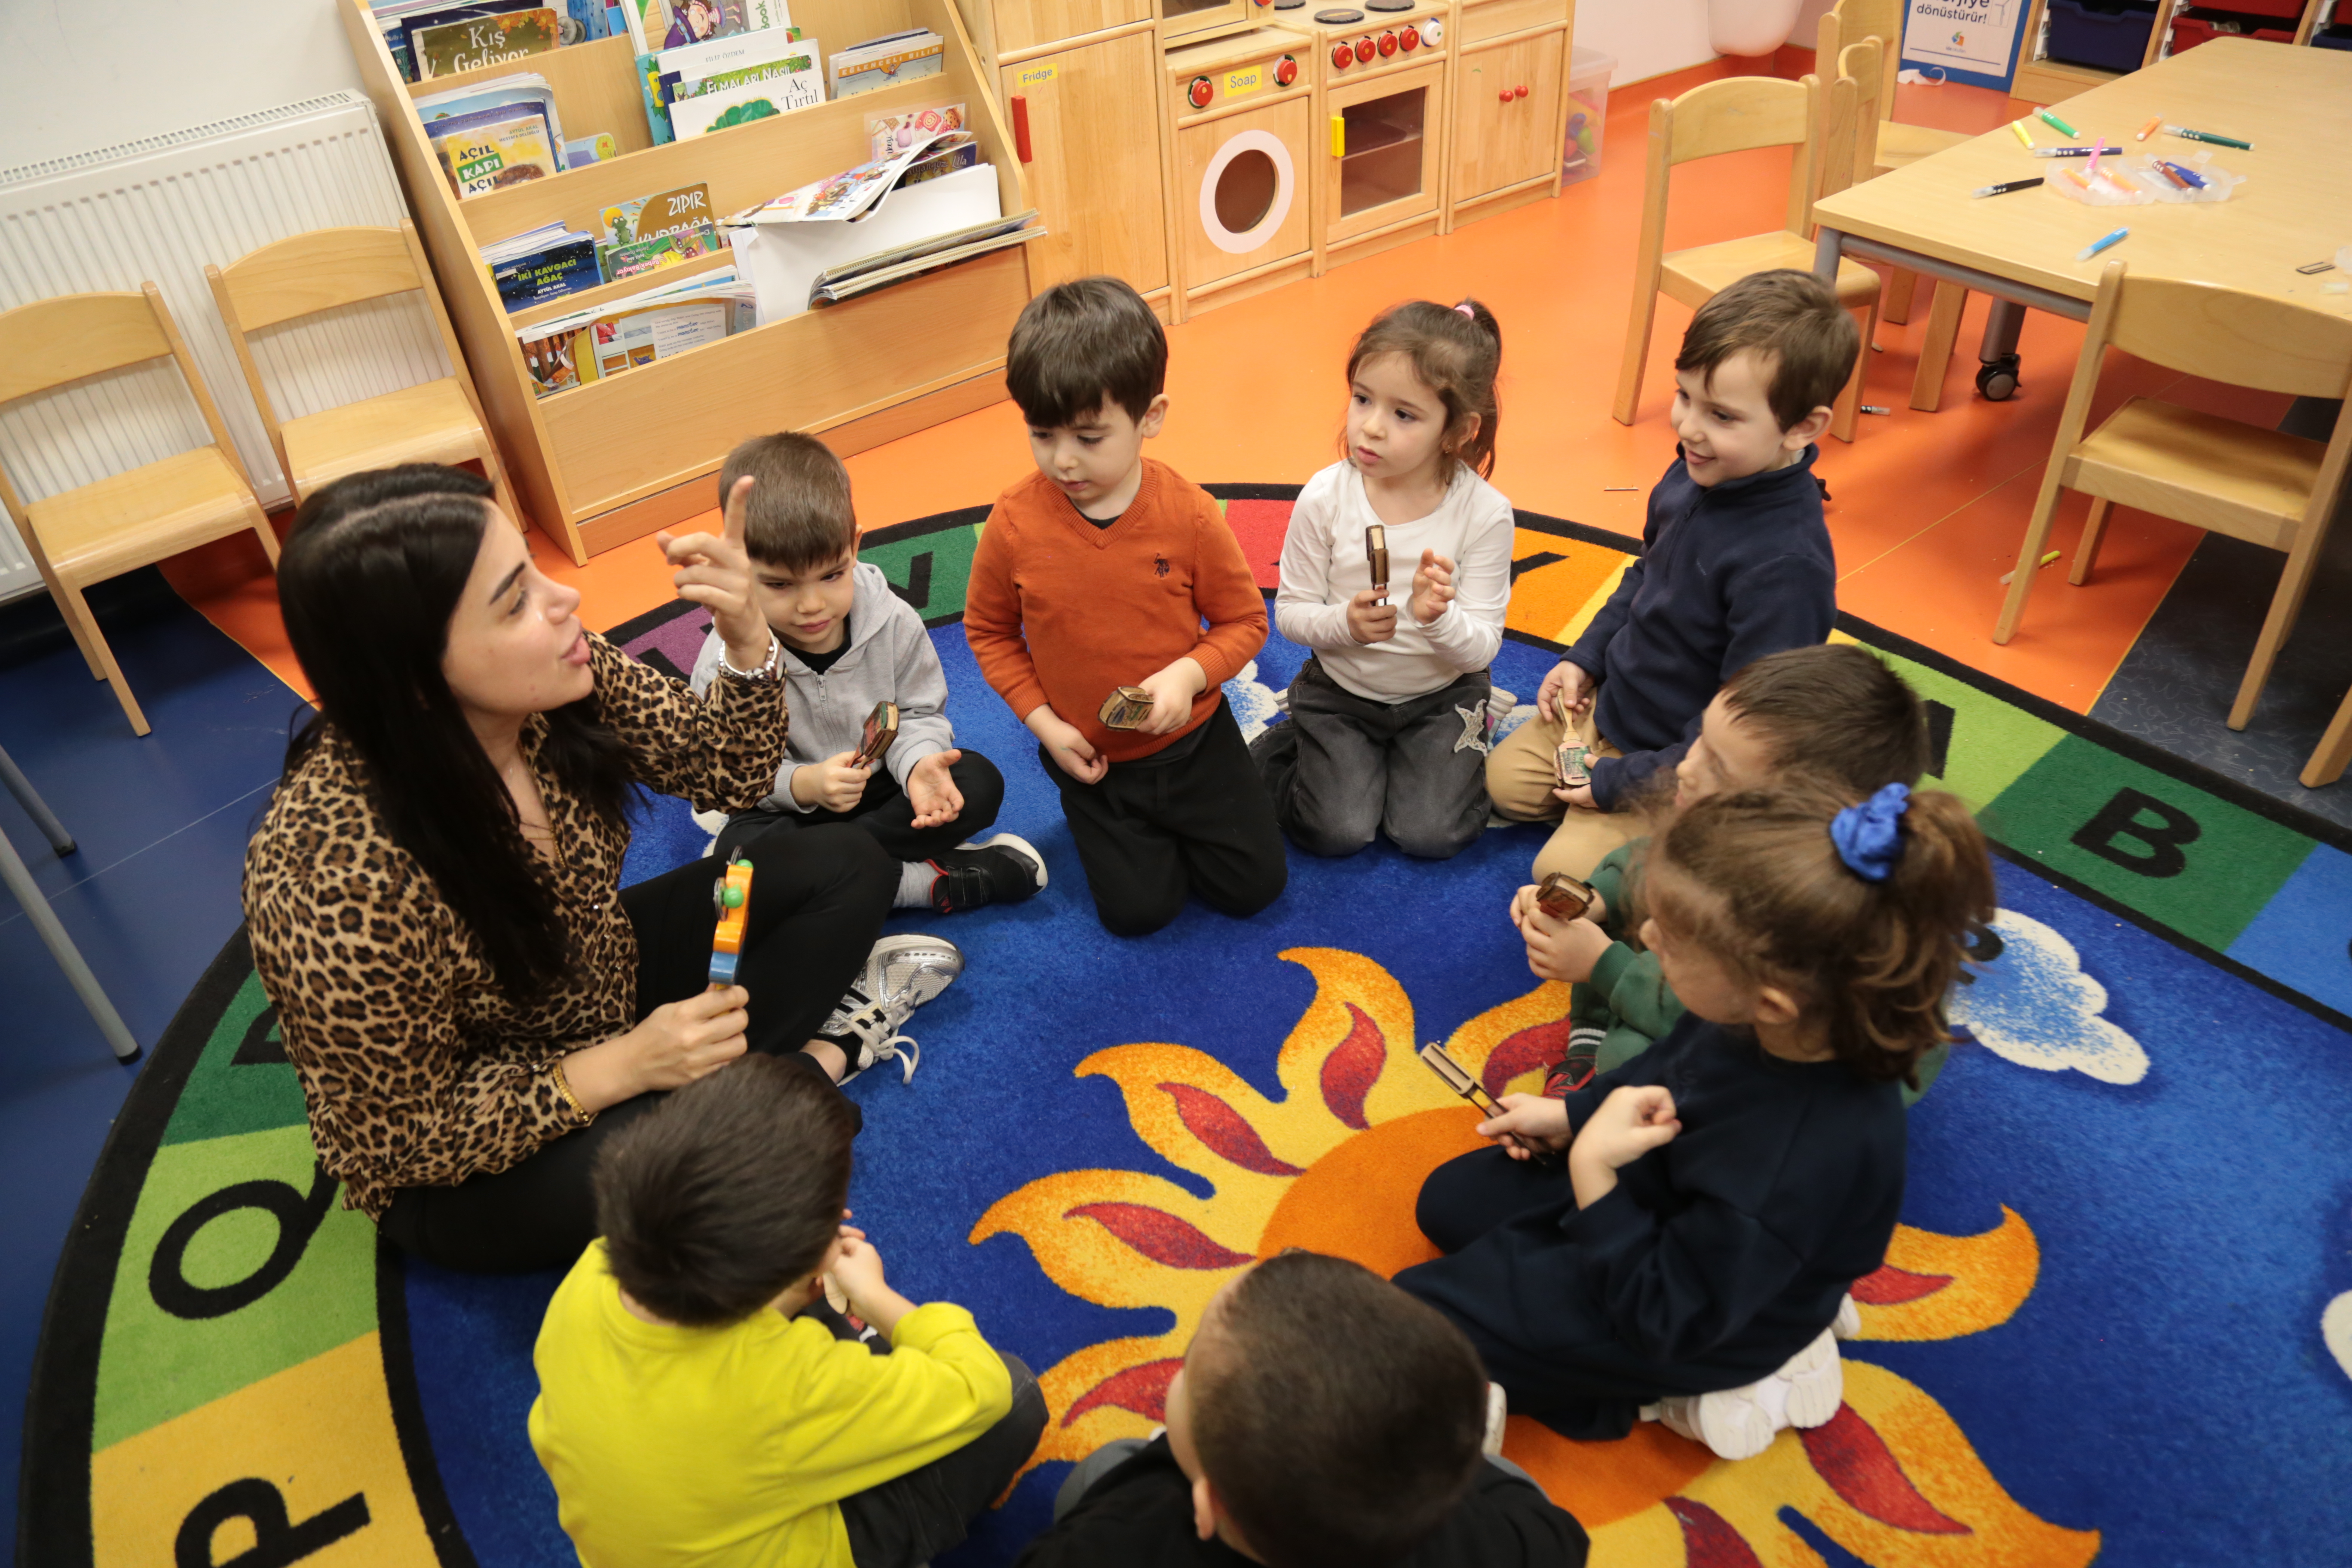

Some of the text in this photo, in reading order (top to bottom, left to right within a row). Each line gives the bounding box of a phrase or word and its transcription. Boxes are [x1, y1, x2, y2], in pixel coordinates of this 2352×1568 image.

[1917, 4, 1987, 24] dönüştürür!
[469, 26, 506, 49] Kış
[723, 49, 745, 58] ÖZDEM
[1023, 69, 1053, 83] Fridge
[1231, 75, 1256, 88] Soap
[789, 78, 808, 94] Aç
[781, 89, 819, 110] Tırtıl
[460, 145, 494, 161] AÇIL
[462, 158, 500, 179] KAPI
[907, 155, 967, 178] alyangoz Lila
[469, 175, 502, 193] AÇIL
[667, 191, 707, 216] ZIPIR
[518, 259, 577, 281] İKİ KAVGACI
[616, 259, 660, 275] Bebek Bakıyor
[537, 273, 563, 286] AĞAÇ
[537, 286, 553, 294] AYTÜL
[677, 322, 698, 330] monster
[677, 327, 699, 336] monster
[2070, 787, 2201, 879] B
[174, 1477, 371, 1568] P
